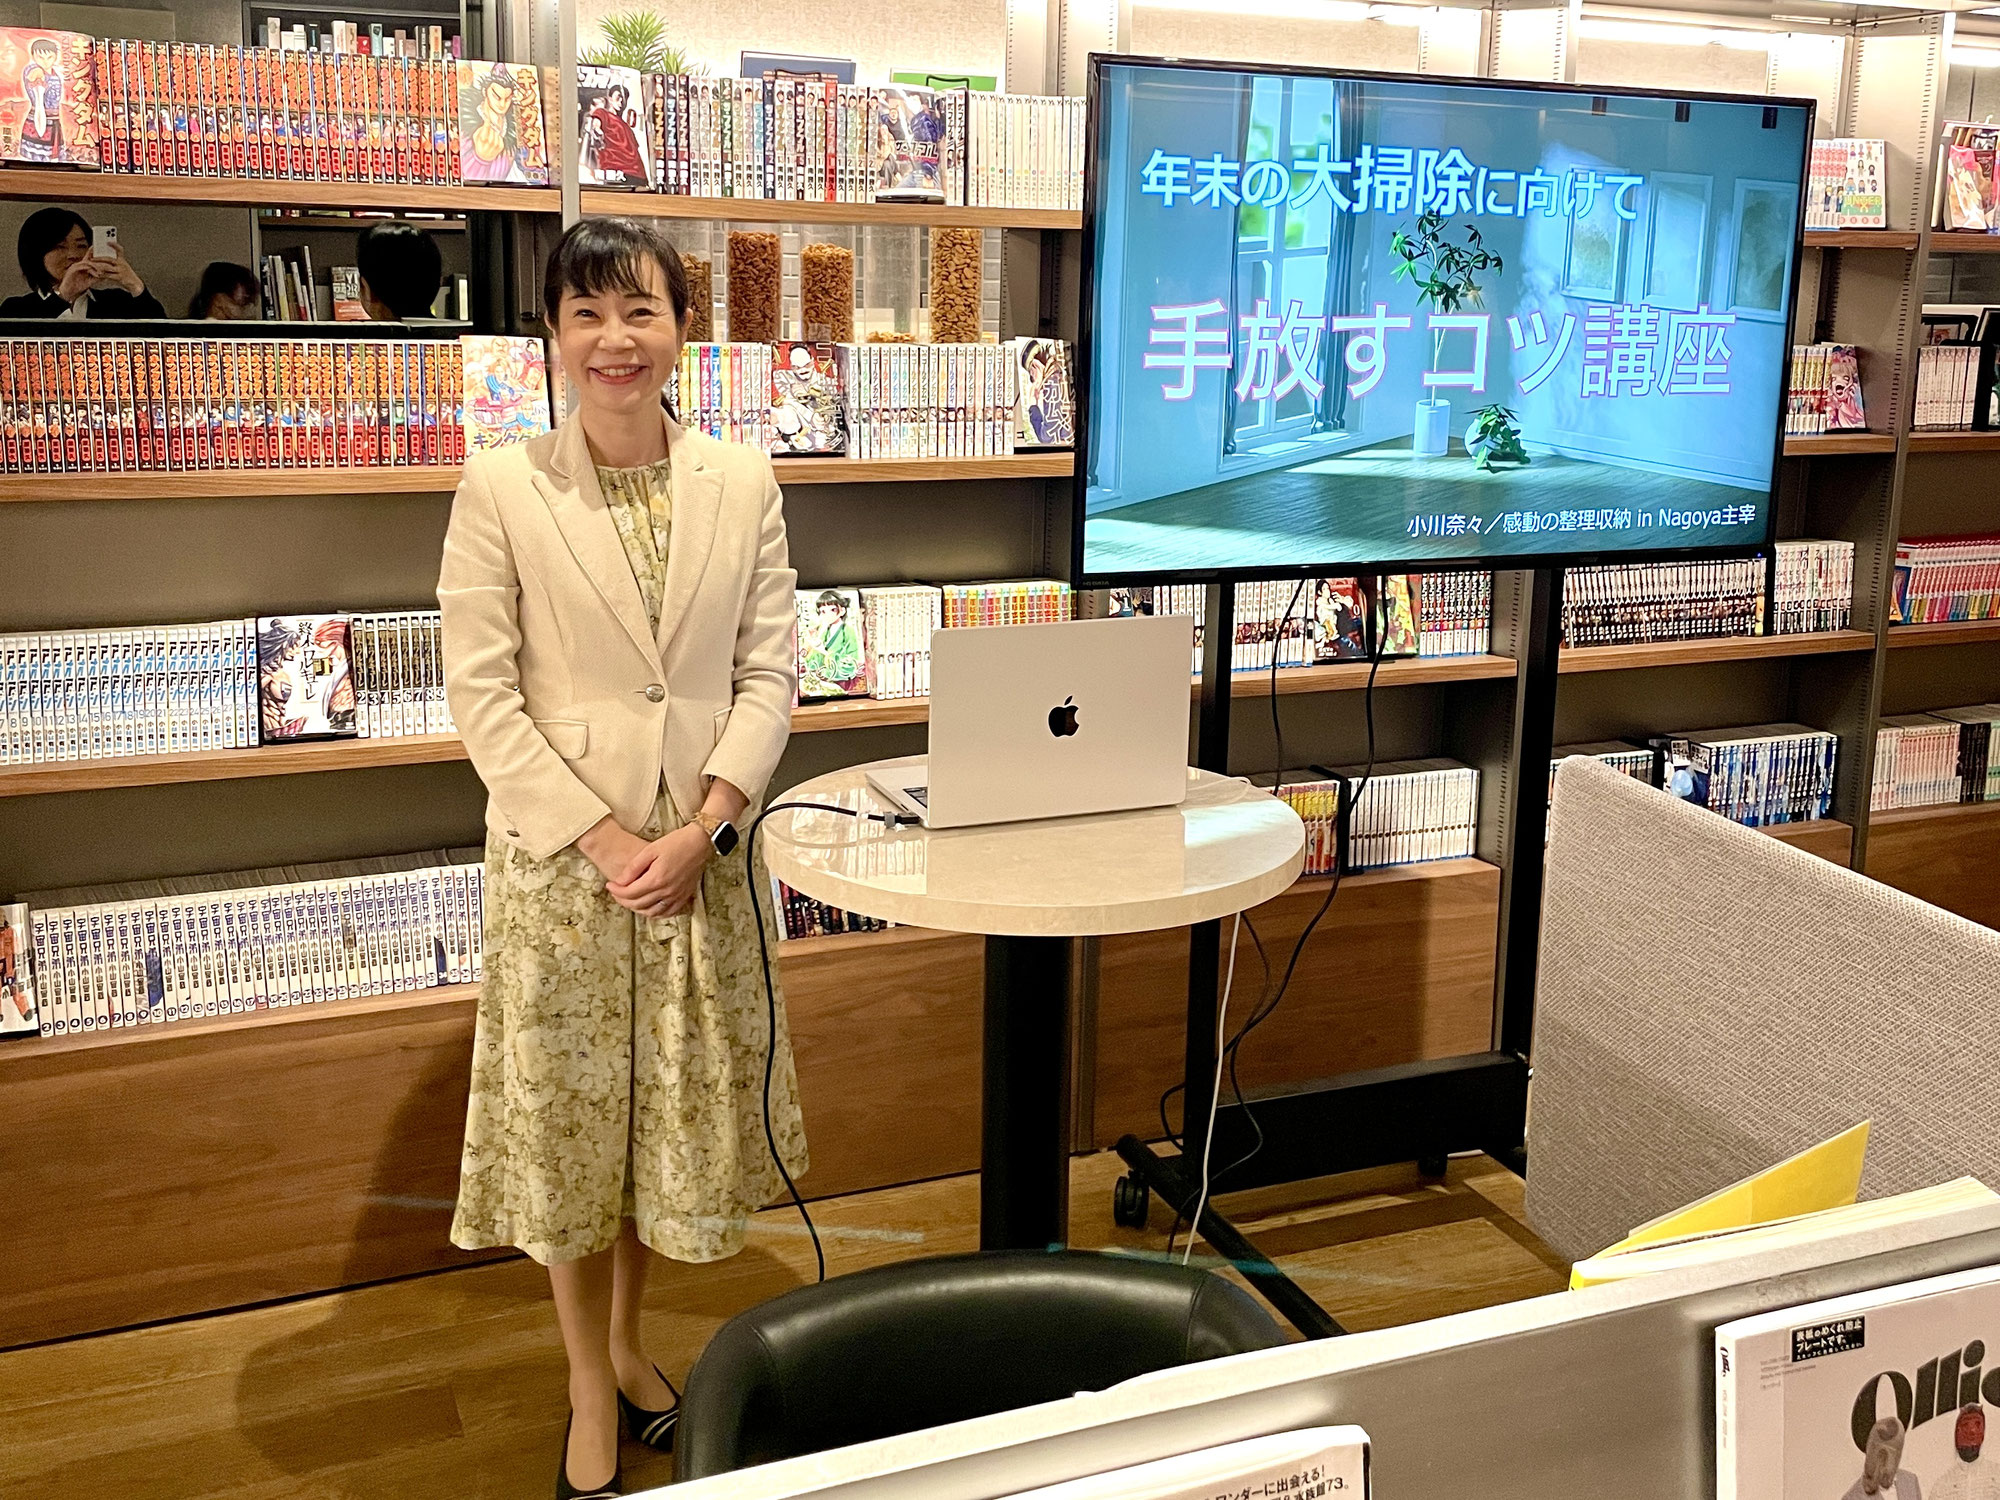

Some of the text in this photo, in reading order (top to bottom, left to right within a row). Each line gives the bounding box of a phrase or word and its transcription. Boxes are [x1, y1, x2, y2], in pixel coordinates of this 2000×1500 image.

[71, 39, 96, 148] キングダム
[516, 68, 545, 168] キングダム
[1140, 144, 1644, 220] 年末の大掃除に向けて
[1143, 299, 1736, 401] 手放すコツ講座
[471, 429, 534, 450] キングダ
[1406, 504, 1756, 538] 小川奈々／感動の整理収納 in Nagoya主宰
[299, 622, 318, 700] 終末ワルキューレ
[357, 692, 366, 704] 2
[380, 692, 389, 704] 4
[392, 692, 400, 704] 5
[403, 690, 412, 702] 6
[414, 690, 422, 701] 7
[426, 689, 434, 700] 8
[436, 688, 444, 700] 9
[369, 694, 378, 705] 3
[200, 707, 210, 715] 25
[223, 704, 232, 712] 27
[248, 702, 257, 710] 29
[102, 712, 111, 721] 16
[135, 710, 144, 718] 19
[146, 709, 155, 717] 20
[158, 709, 166, 717] 21
[170, 708, 179, 716] 22
[180, 708, 188, 716] 23
[190, 708, 199, 716] 24
[22, 717, 28, 726] 9
[56, 716, 64, 725] 12
[66, 715, 76, 724] 13
[79, 714, 88, 722] 14
[90, 713, 100, 722] 15
[11, 718, 17, 728] 8
